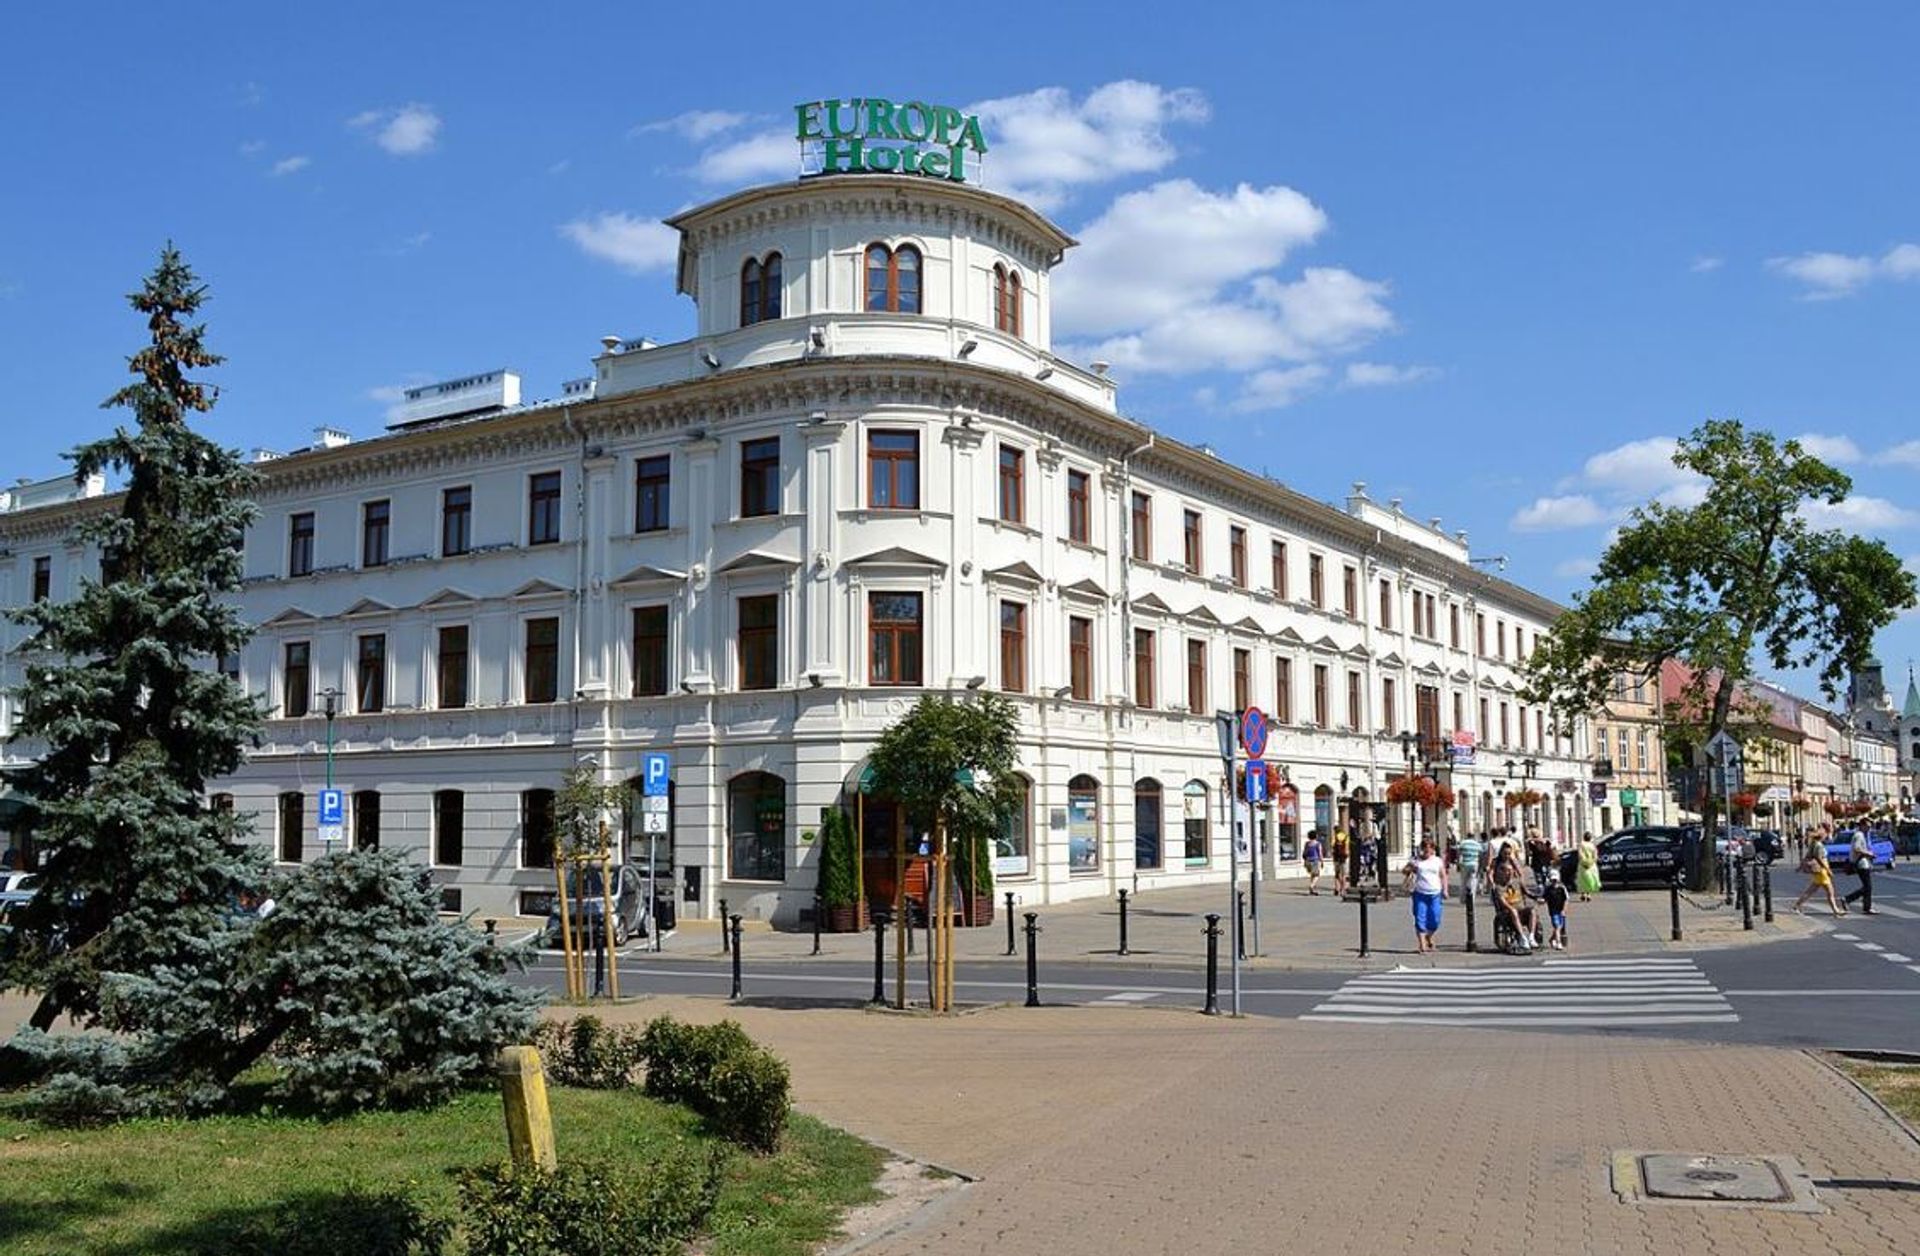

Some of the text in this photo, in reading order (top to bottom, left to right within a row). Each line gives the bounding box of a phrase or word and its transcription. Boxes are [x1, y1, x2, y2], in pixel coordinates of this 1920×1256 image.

[794, 98, 988, 153] EUROPA
[822, 138, 965, 182] Hotel
[649, 757, 665, 785] P
[324, 792, 338, 815] P
